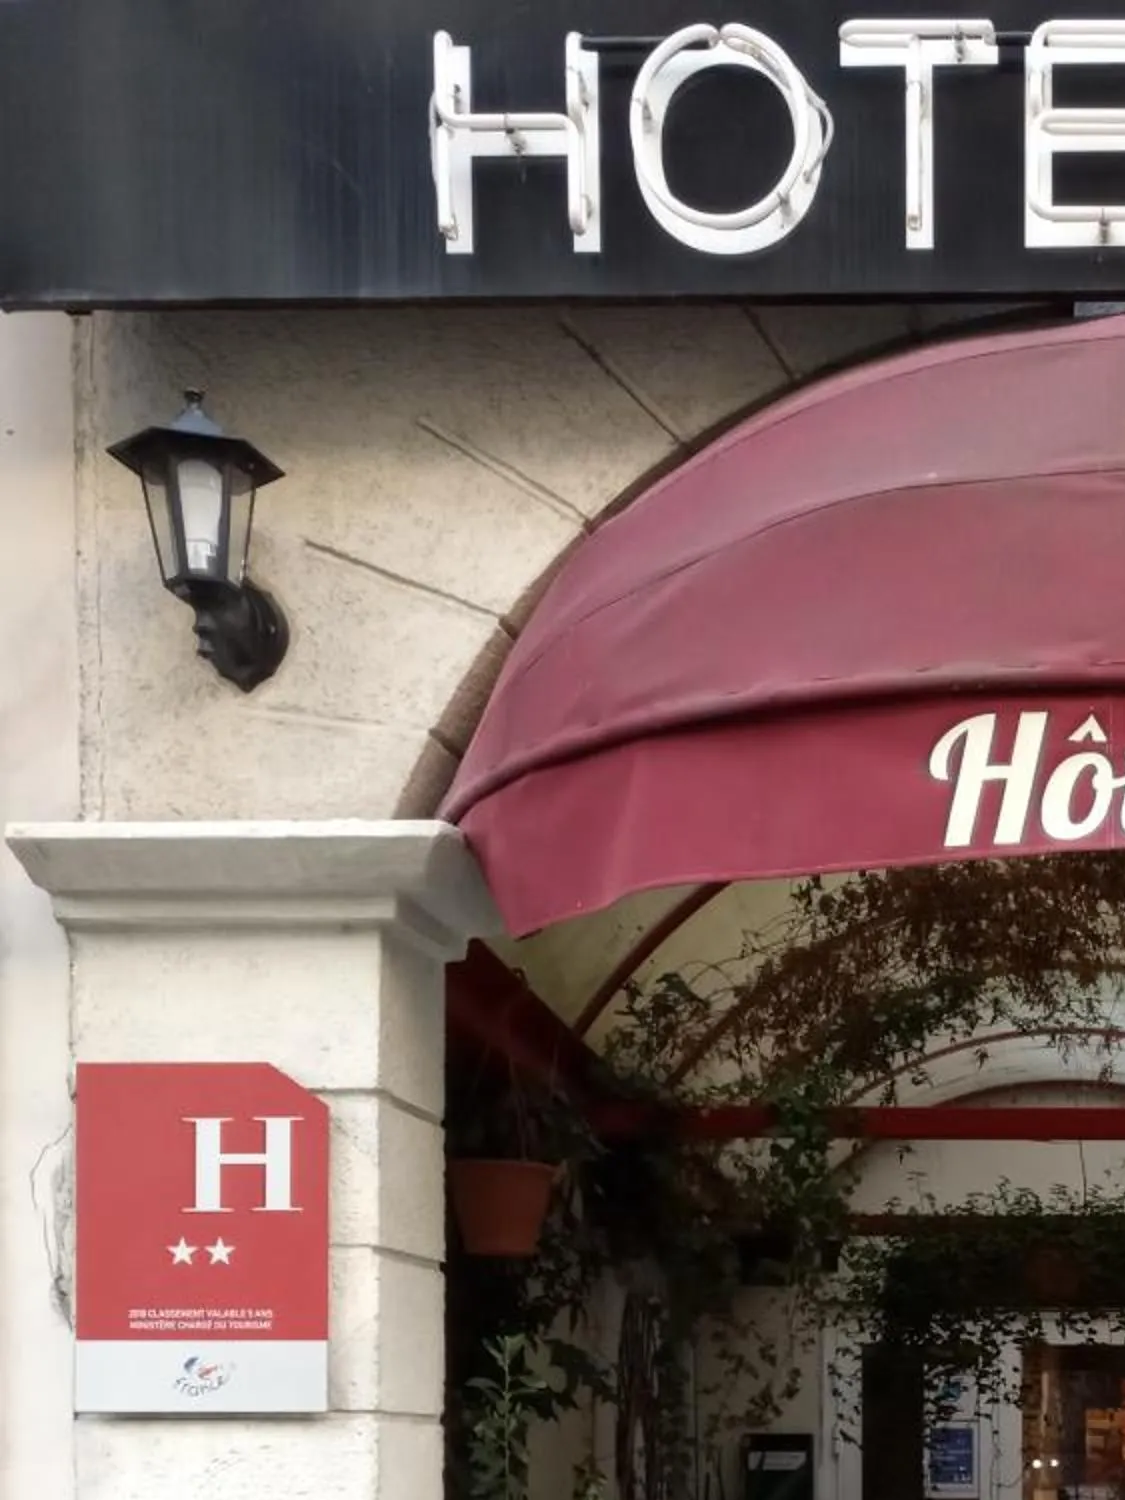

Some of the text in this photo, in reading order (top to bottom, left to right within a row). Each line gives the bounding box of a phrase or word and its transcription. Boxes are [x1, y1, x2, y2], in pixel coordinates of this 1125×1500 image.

[181, 1115, 304, 1213] H
[147, 1309, 204, 1319] CLASSEMENT
[206, 1309, 246, 1319] VALABLE
[255, 1309, 273, 1319] ANS
[213, 1320, 226, 1329] DU
[228, 1320, 273, 1329] TOURISME
